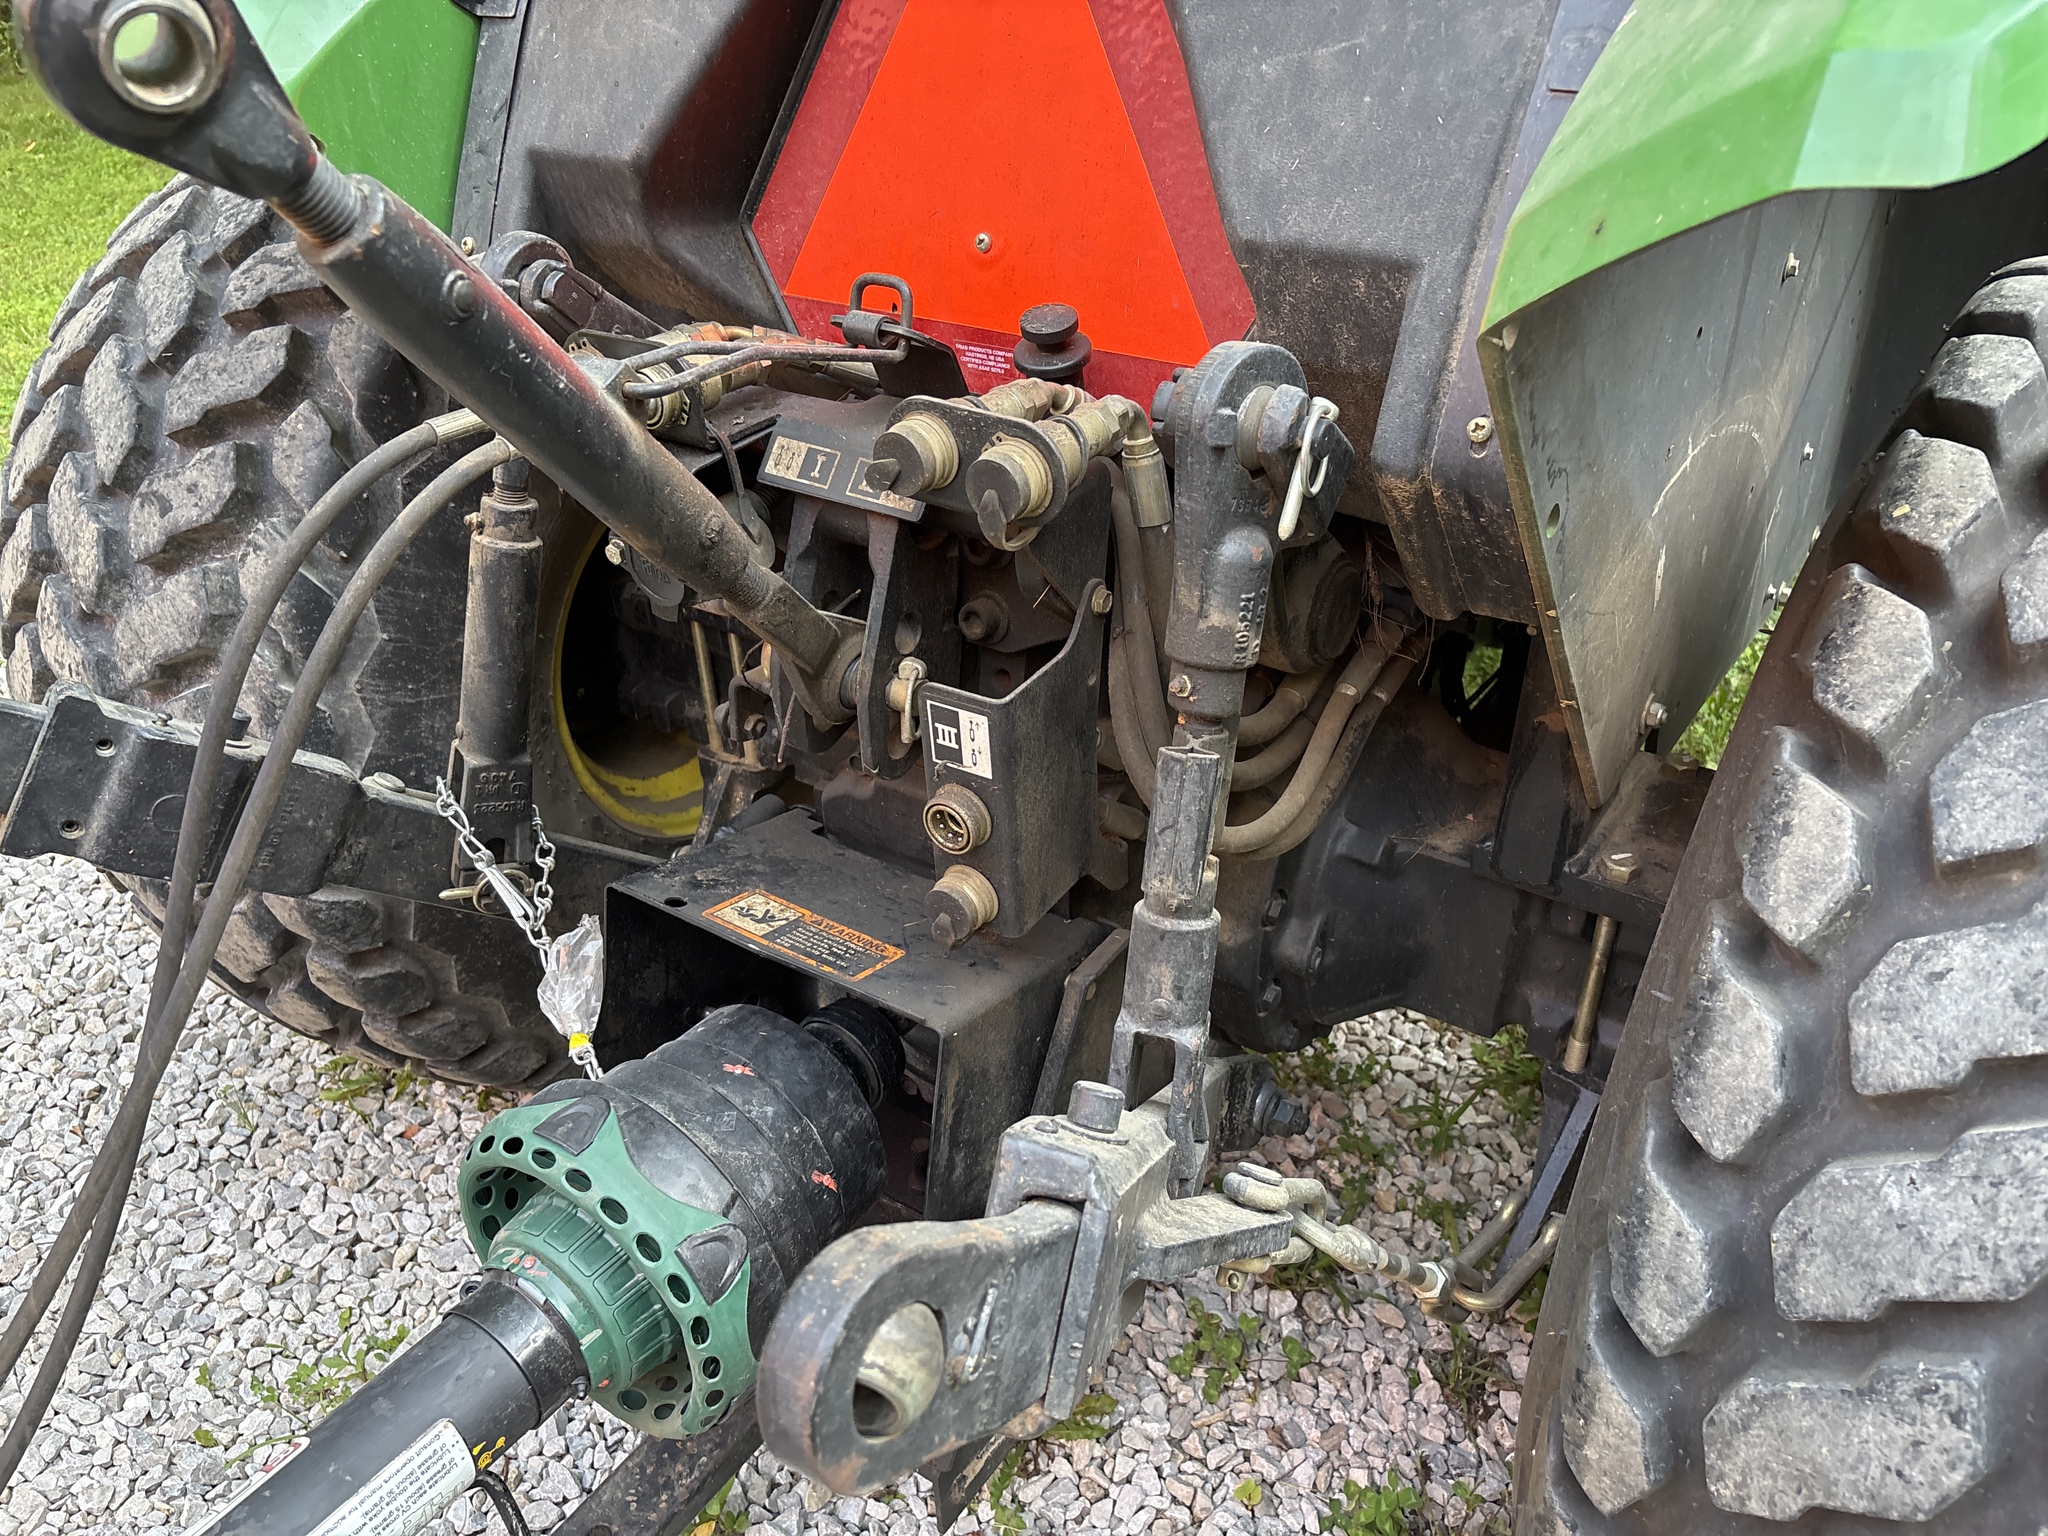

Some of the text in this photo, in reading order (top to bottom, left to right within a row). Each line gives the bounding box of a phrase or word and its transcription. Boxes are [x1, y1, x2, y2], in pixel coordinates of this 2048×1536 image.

[983, 360, 1010, 369] COMPLIANCE
[934, 722, 960, 750] III
[775, 939, 791, 947] RPM
[780, 936, 806, 948] Operate
[785, 933, 812, 947] clothing
[791, 930, 808, 939] Keep
[797, 927, 814, 936] Keep
[823, 939, 847, 950] shields
[819, 931, 844, 943] INJURY
[844, 941, 865, 952] FROM
[865, 950, 880, 959] PTO
[825, 924, 887, 953] WARNING
[416, 1433, 440, 1458] Consult
[361, 1442, 446, 1521] of grease (about 30 grams).
[384, 1454, 414, 1485] operators
[429, 1462, 458, 1491] Lubricate
[353, 1448, 450, 1536] Lubricate the double yoke with
[359, 1482, 383, 1507] manual
[369, 1457, 455, 1536] of grease (about 15 grams).
[412, 1489, 427, 1505] each
[347, 1505, 357, 1516] for
[401, 1504, 411, 1516] CV
[382, 1514, 400, 1532] cross
